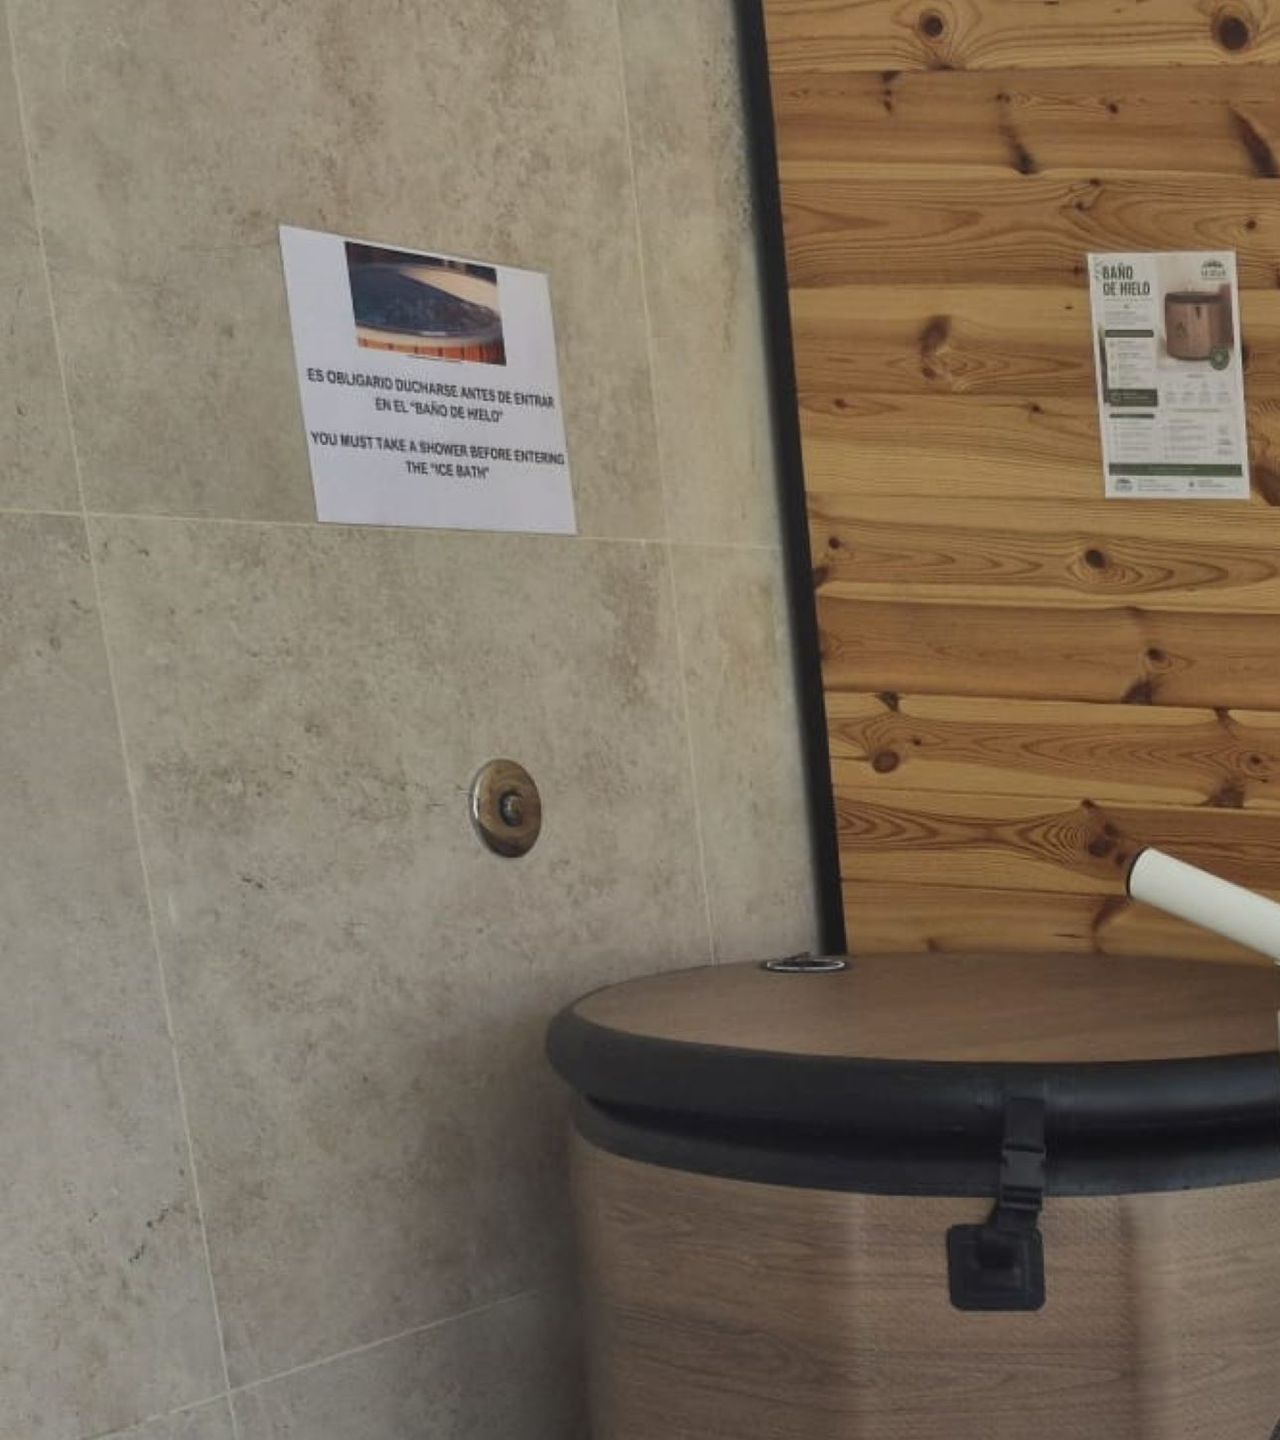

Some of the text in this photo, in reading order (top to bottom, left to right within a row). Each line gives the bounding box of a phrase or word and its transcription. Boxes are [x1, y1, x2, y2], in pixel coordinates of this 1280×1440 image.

[1102, 262, 1134, 280] BAÑO
[1103, 281, 1151, 296] DE HIELO
[307, 368, 324, 382] ES
[396, 380, 457, 398] DUCHARSE
[461, 386, 495, 402] ANTES
[498, 391, 512, 404] DE
[514, 392, 554, 408] ENTRAR
[375, 398, 392, 411] EN
[394, 400, 409, 413] EL
[450, 406, 465, 419] DE
[311, 431, 565, 465] YOU MUST TAKE A SHOWER BEFORE ENTERING
[406, 460, 429, 475] THE
